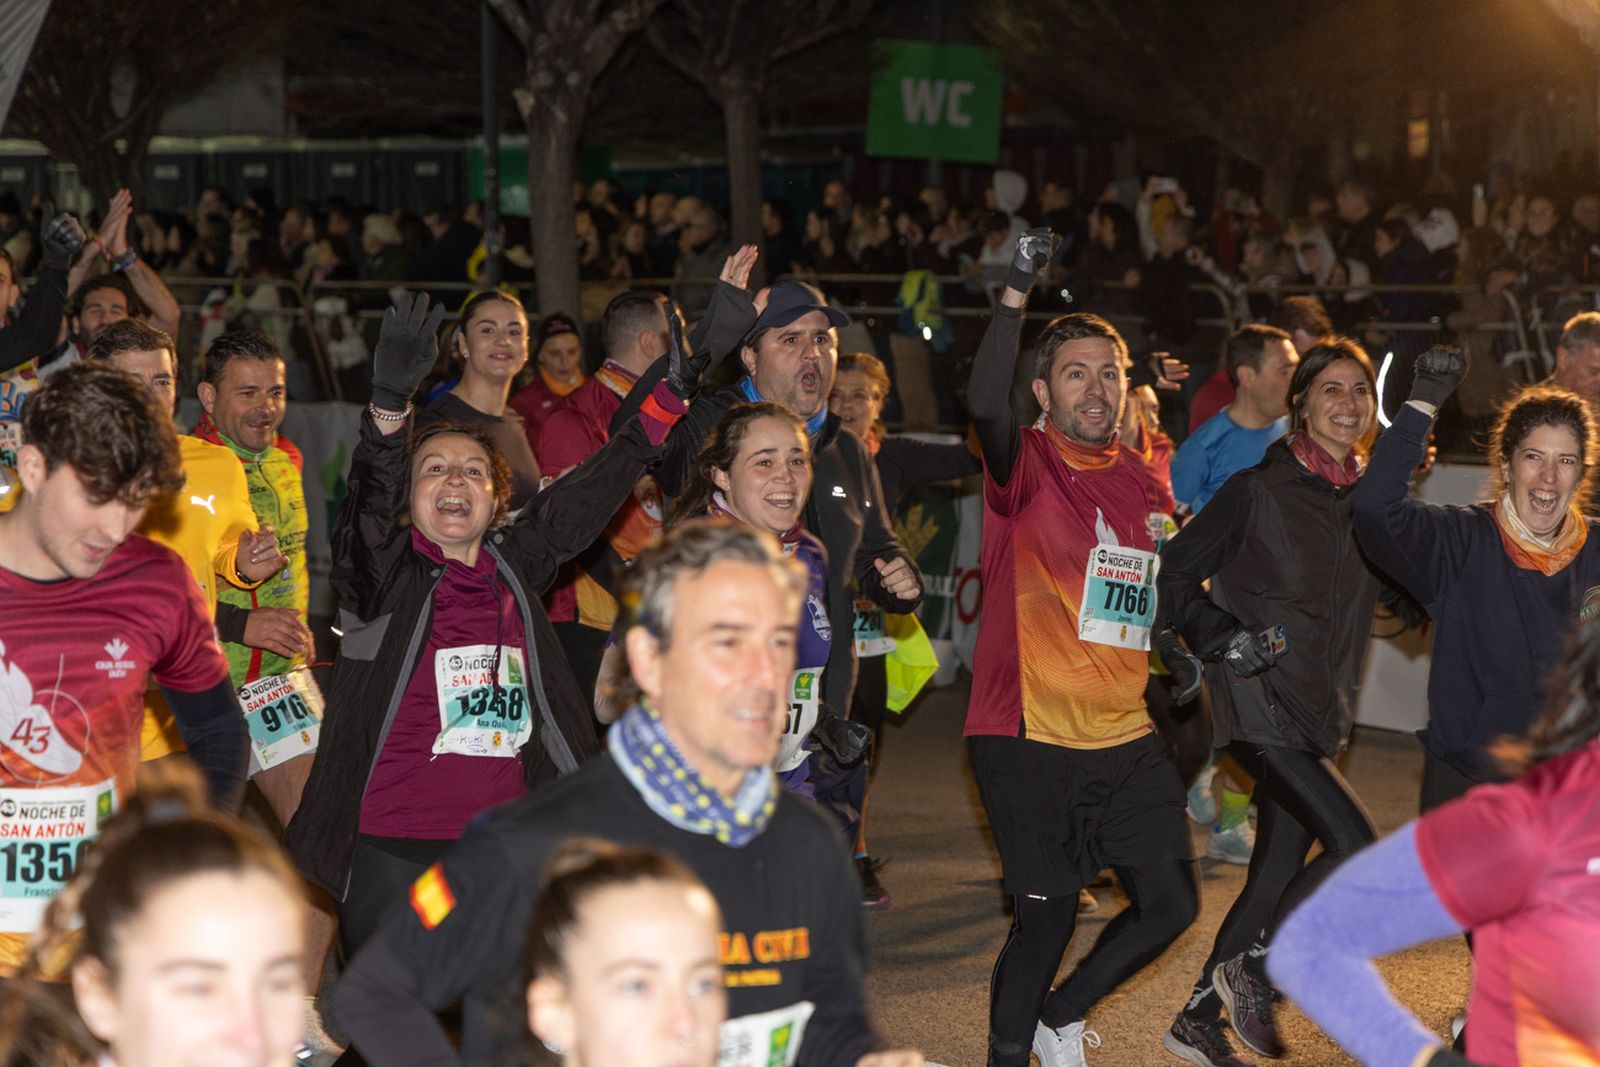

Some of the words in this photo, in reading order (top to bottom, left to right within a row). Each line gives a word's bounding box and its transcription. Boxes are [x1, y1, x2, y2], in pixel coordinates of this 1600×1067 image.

[901, 78, 975, 127] WC
[1108, 556, 1133, 571] NOCHE
[1133, 560, 1143, 571] DE
[1096, 566, 1114, 578] SAN
[1114, 569, 1142, 583] ANTÓN
[1104, 581, 1148, 616] 7766
[252, 677, 280, 696] NOCHE
[247, 696, 266, 712] SAN
[10, 718, 51, 754] 43
[20, 805, 66, 819] NOCHE
[70, 804, 86, 818] DE
[0, 823, 31, 838] SAN
[35, 820, 86, 838] ANTÓN
